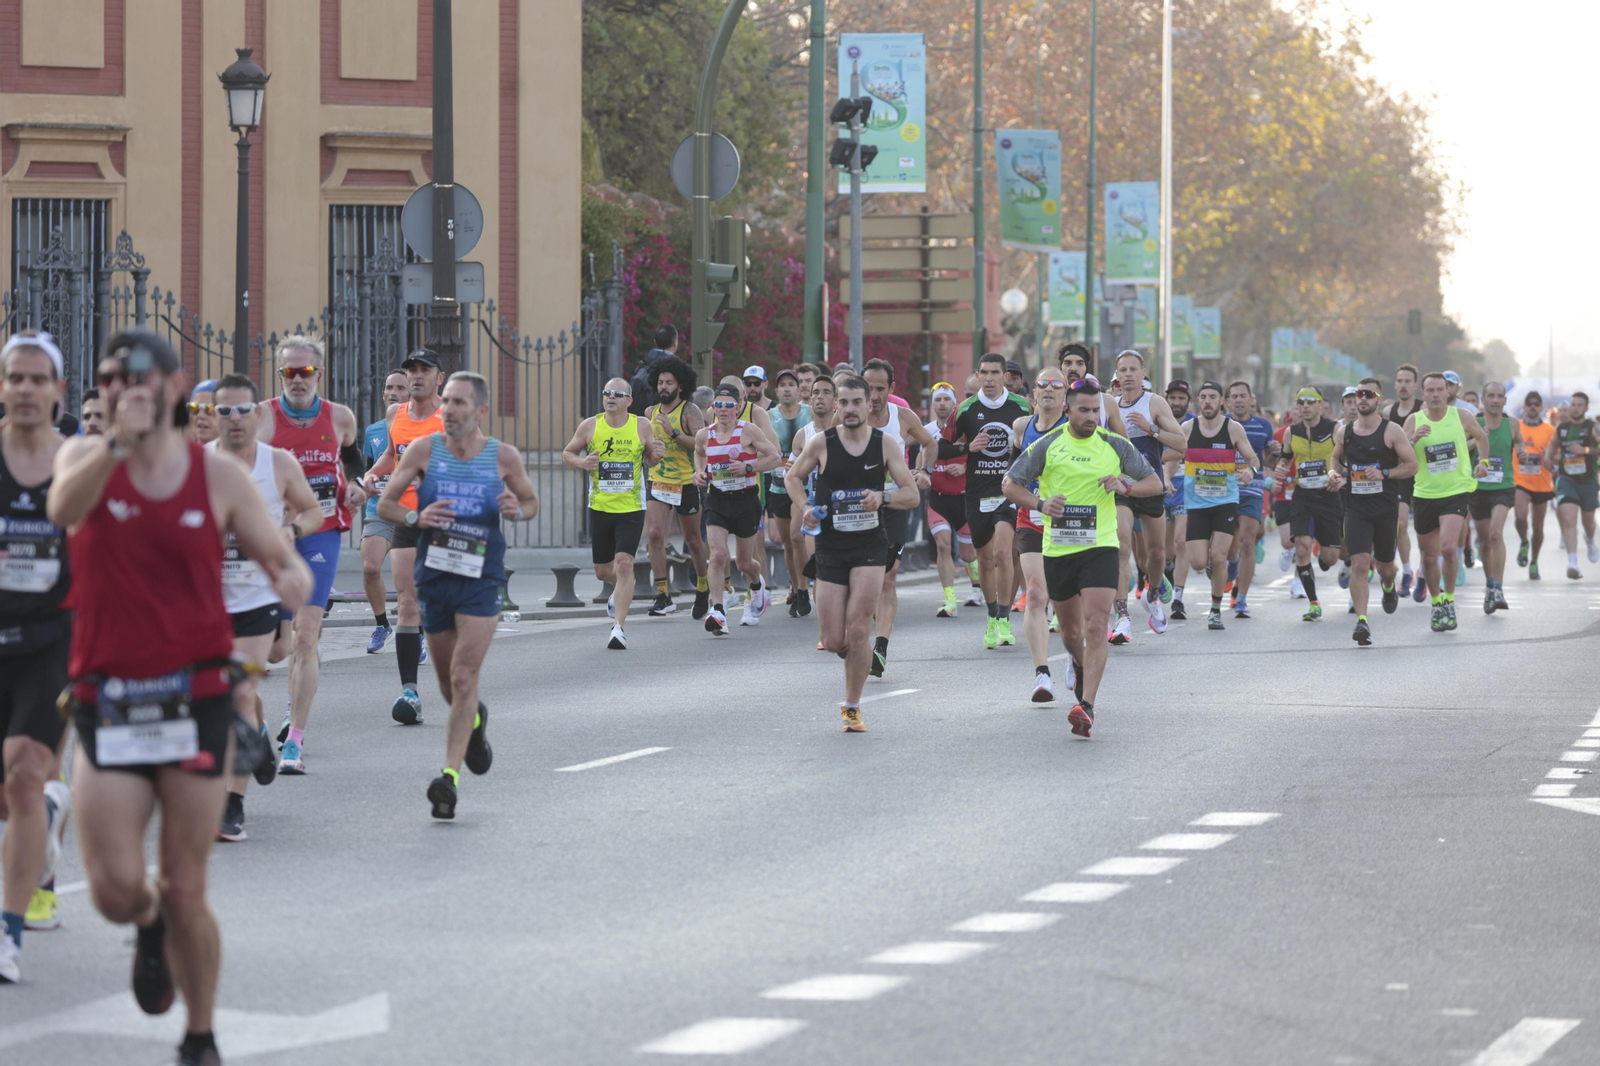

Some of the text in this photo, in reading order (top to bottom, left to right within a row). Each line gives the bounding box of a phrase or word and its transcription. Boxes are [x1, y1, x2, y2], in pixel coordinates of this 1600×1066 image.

[1433, 443, 1454, 452] ZURICH
[289, 447, 333, 463] alifas
[305, 476, 330, 485] URICH
[846, 490, 863, 498] ZUR
[1065, 506, 1092, 514] ZURICH
[837, 514, 858, 522] BOITIER
[1065, 519, 1082, 527] 1835
[7, 520, 54, 536] ZURICH
[451, 522, 484, 535] ZURICH
[447, 538, 468, 551] 2153
